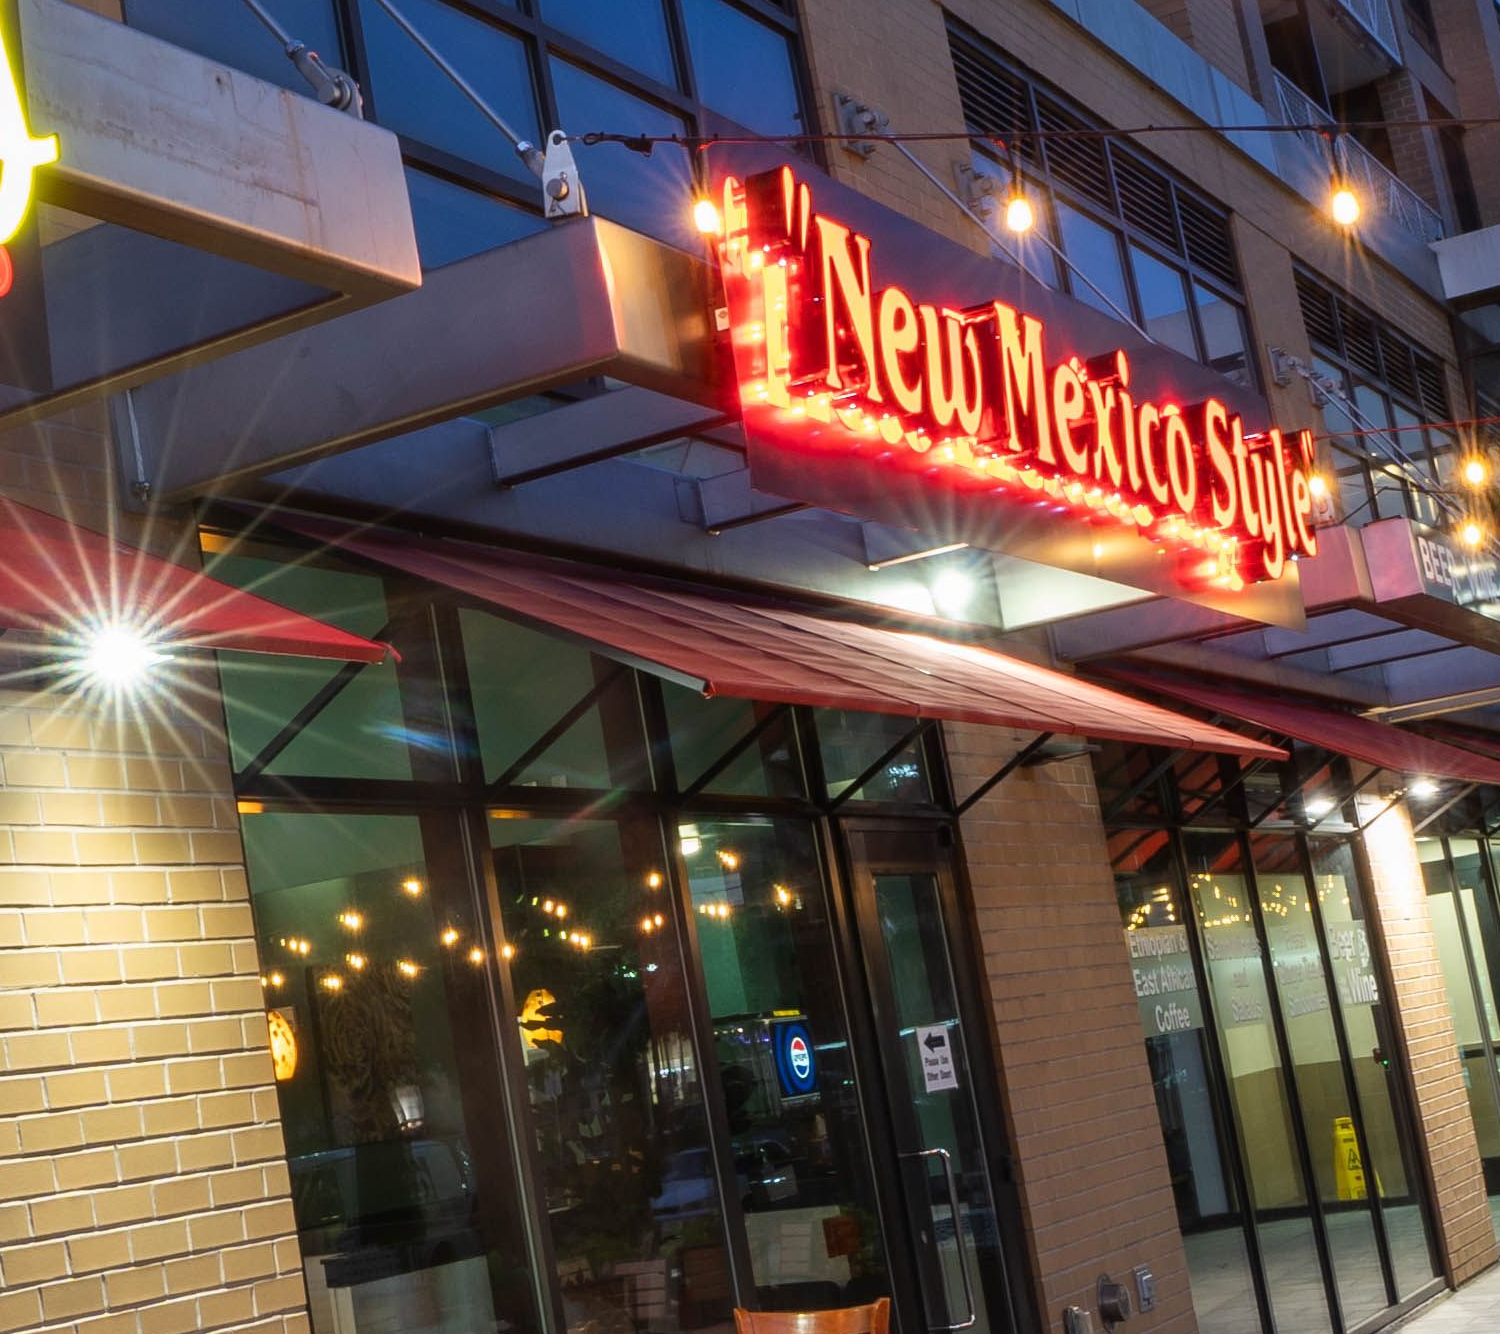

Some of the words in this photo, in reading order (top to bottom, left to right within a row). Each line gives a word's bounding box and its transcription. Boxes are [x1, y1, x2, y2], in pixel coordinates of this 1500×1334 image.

[994, 301, 1196, 507] Mexico
[1127, 930, 1178, 961] Ethiopian
[1133, 969, 1158, 997] East
[1160, 964, 1195, 995] African
[1347, 969, 1379, 1004] Wine
[1155, 1002, 1191, 1033] Coffee
